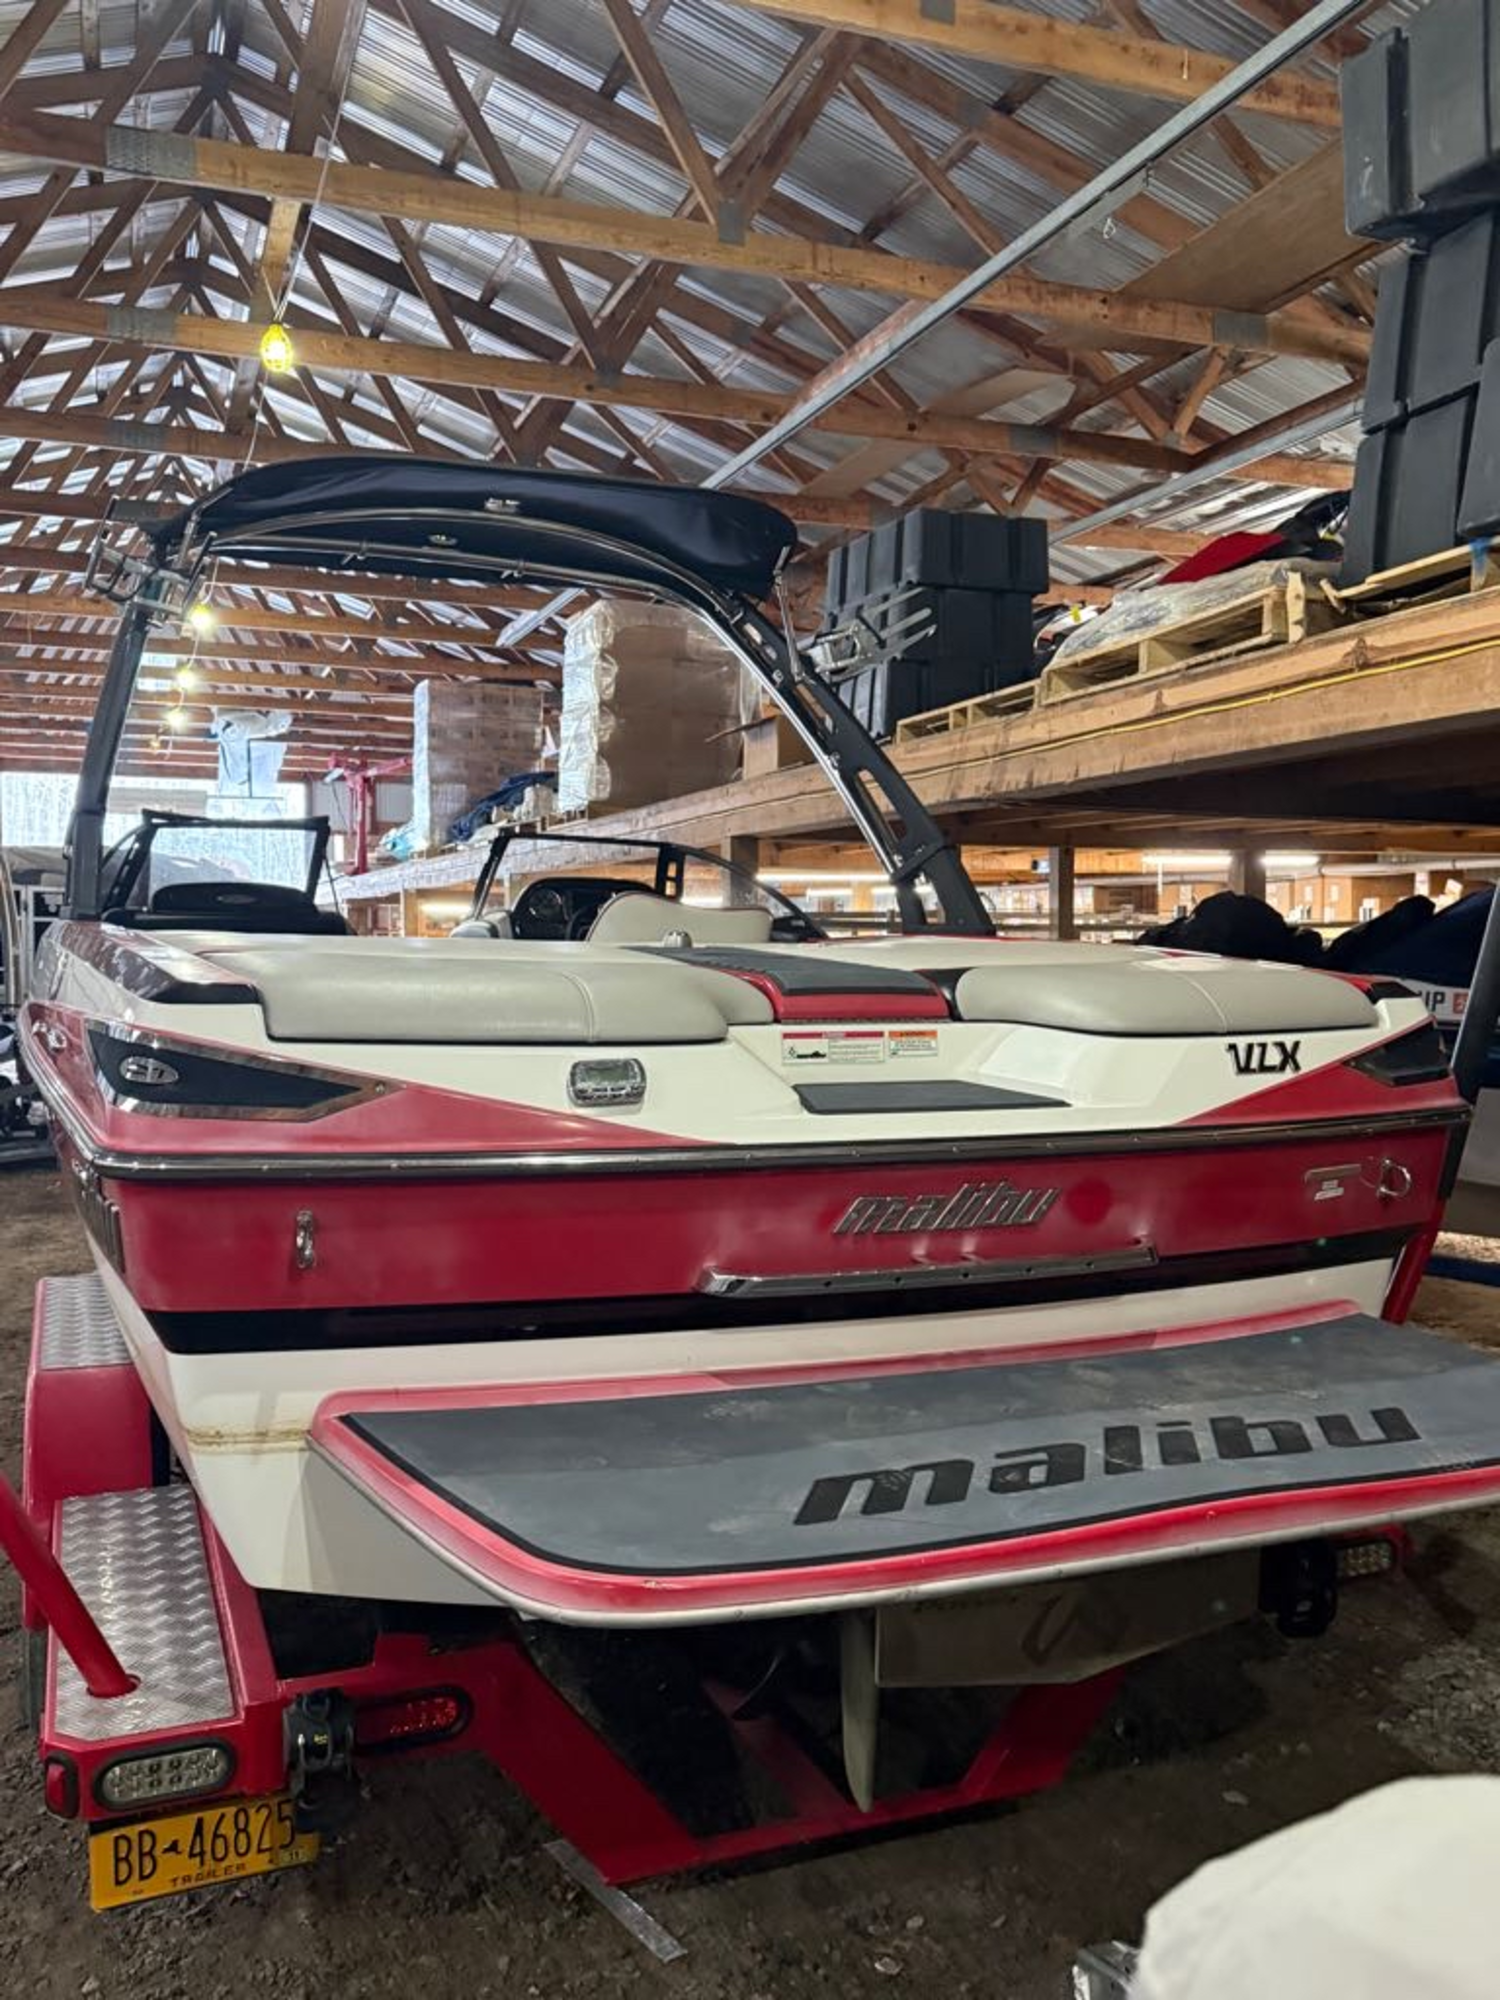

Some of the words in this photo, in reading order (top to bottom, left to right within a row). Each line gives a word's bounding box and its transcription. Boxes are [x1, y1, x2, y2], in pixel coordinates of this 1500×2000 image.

[1226, 1040, 1301, 1074] VLX
[832, 1180, 1062, 1234] malibu
[793, 1407, 1422, 1526] malibu
[170, 1862, 247, 1888] TRAILER
